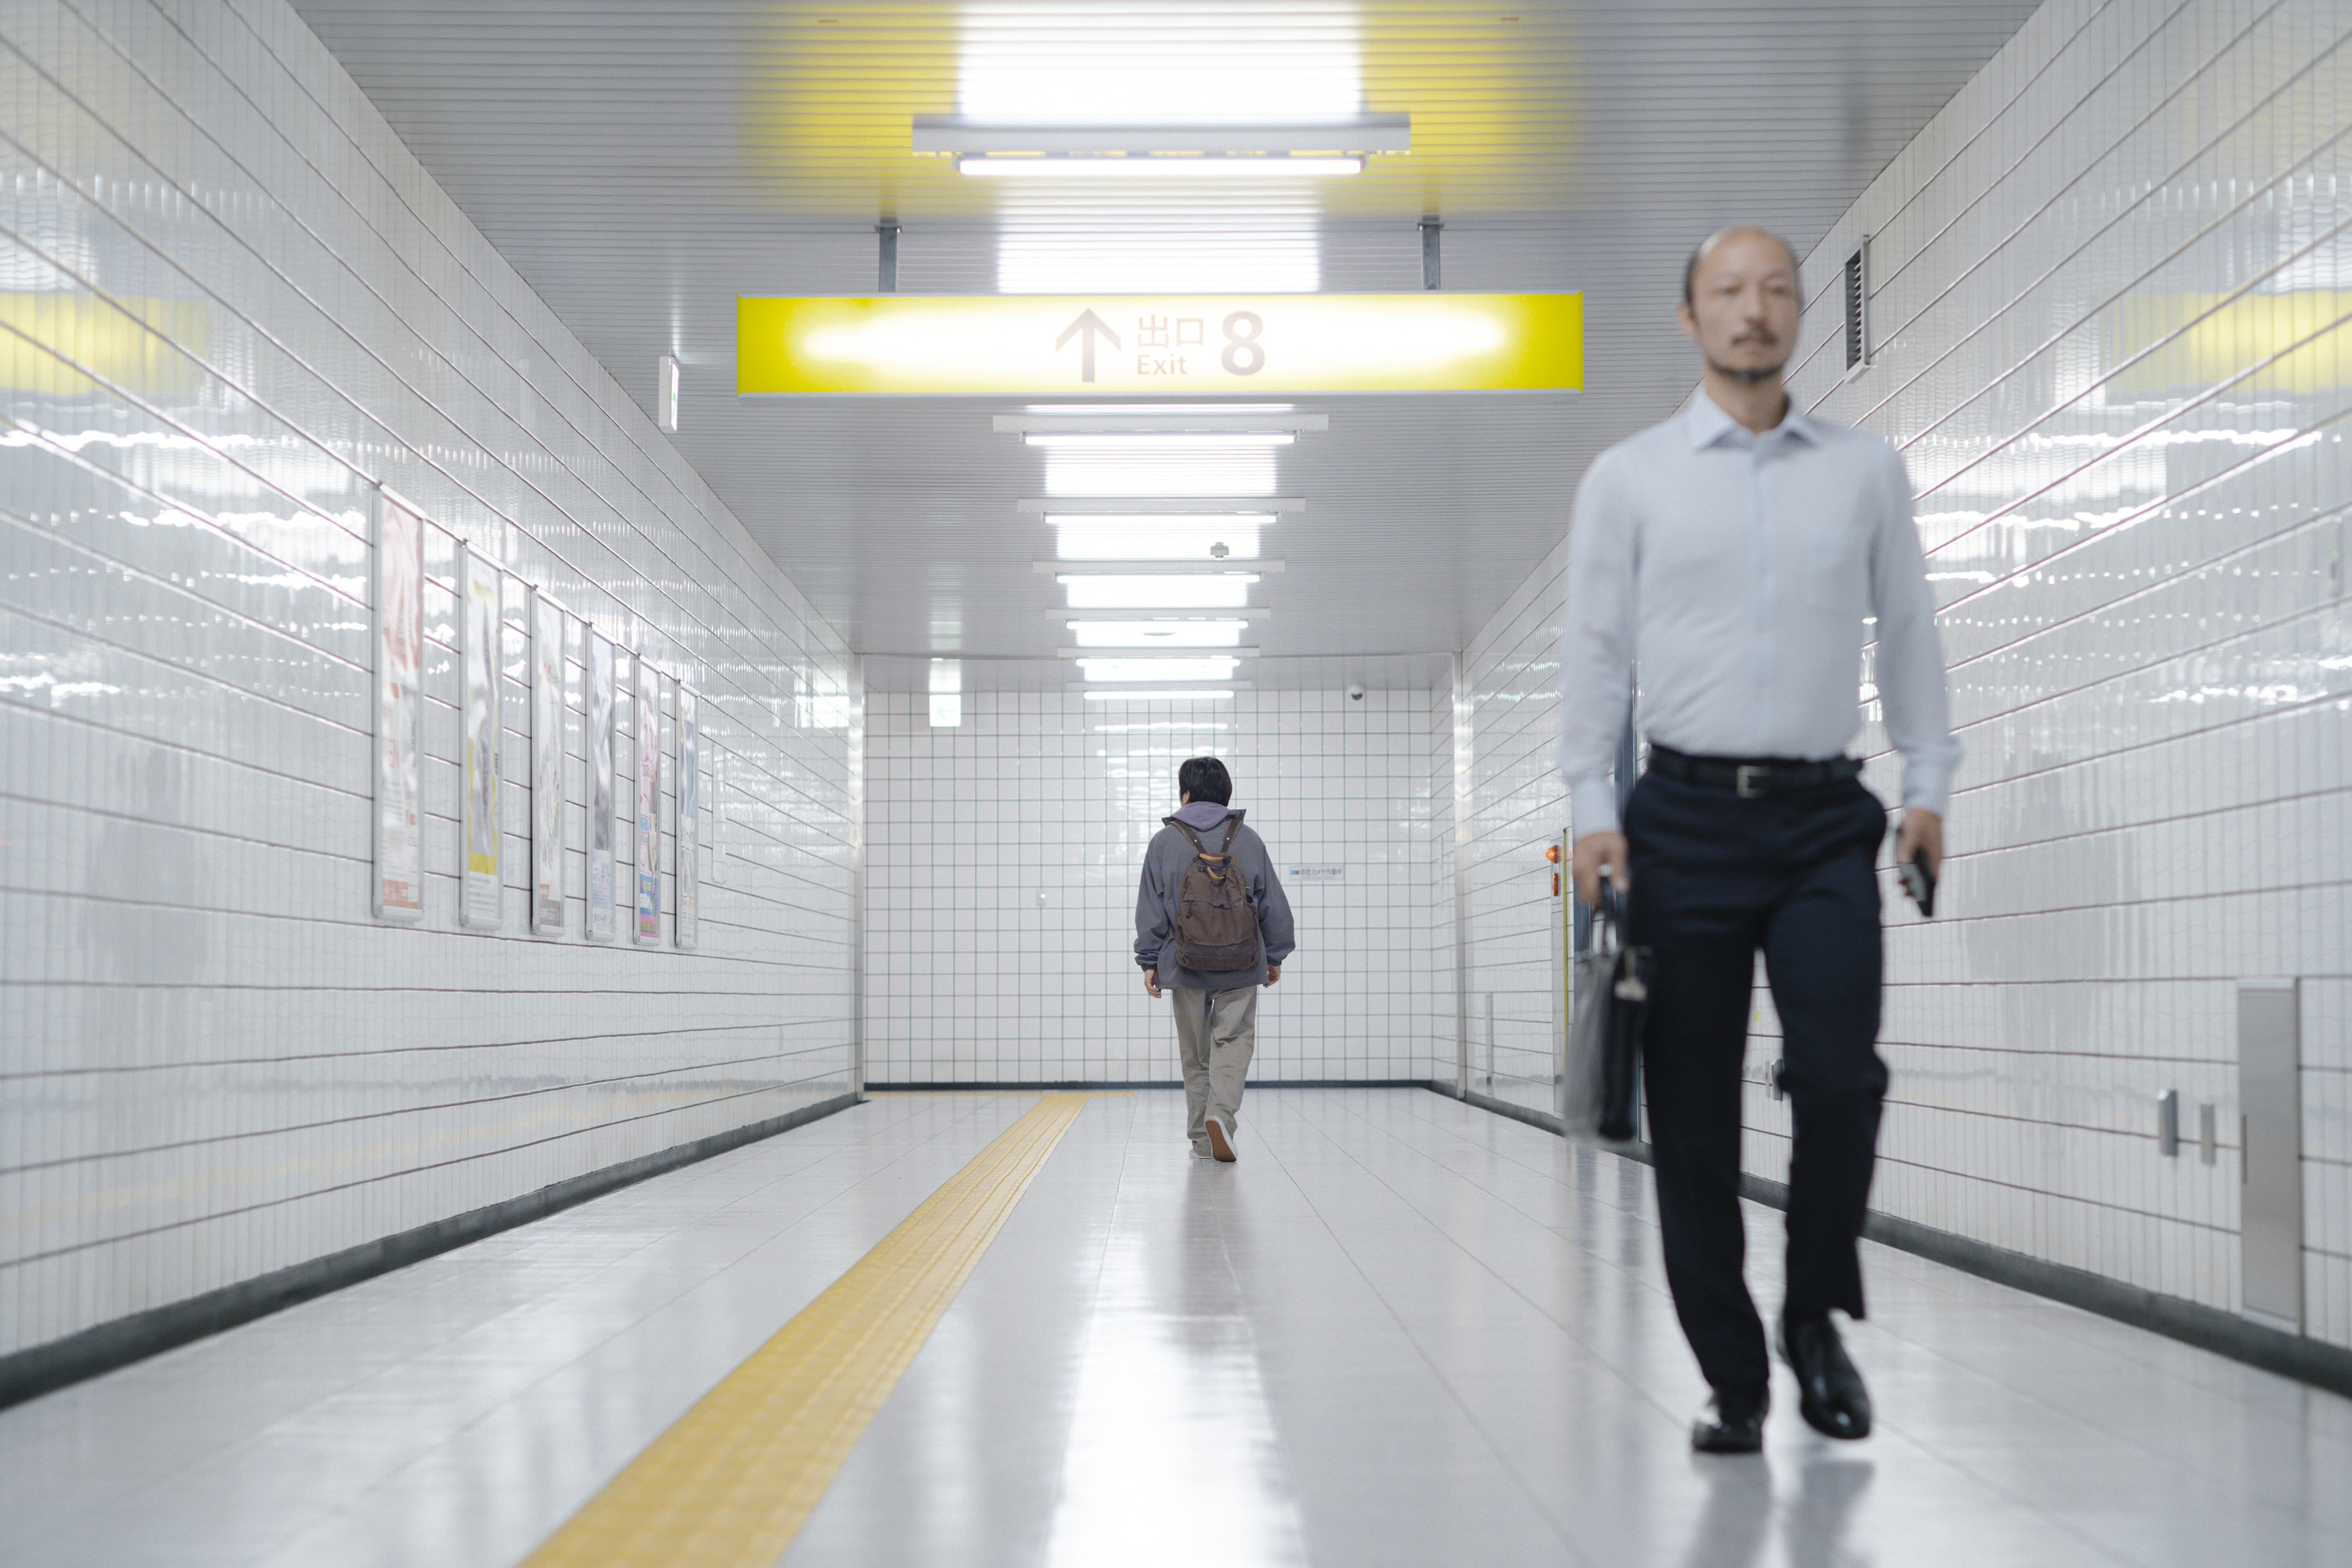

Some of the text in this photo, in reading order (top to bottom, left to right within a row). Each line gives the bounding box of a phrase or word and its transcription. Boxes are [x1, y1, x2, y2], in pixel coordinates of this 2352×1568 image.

[1138, 310, 1265, 376] 出口 8
[1138, 354, 1189, 376] Exit
